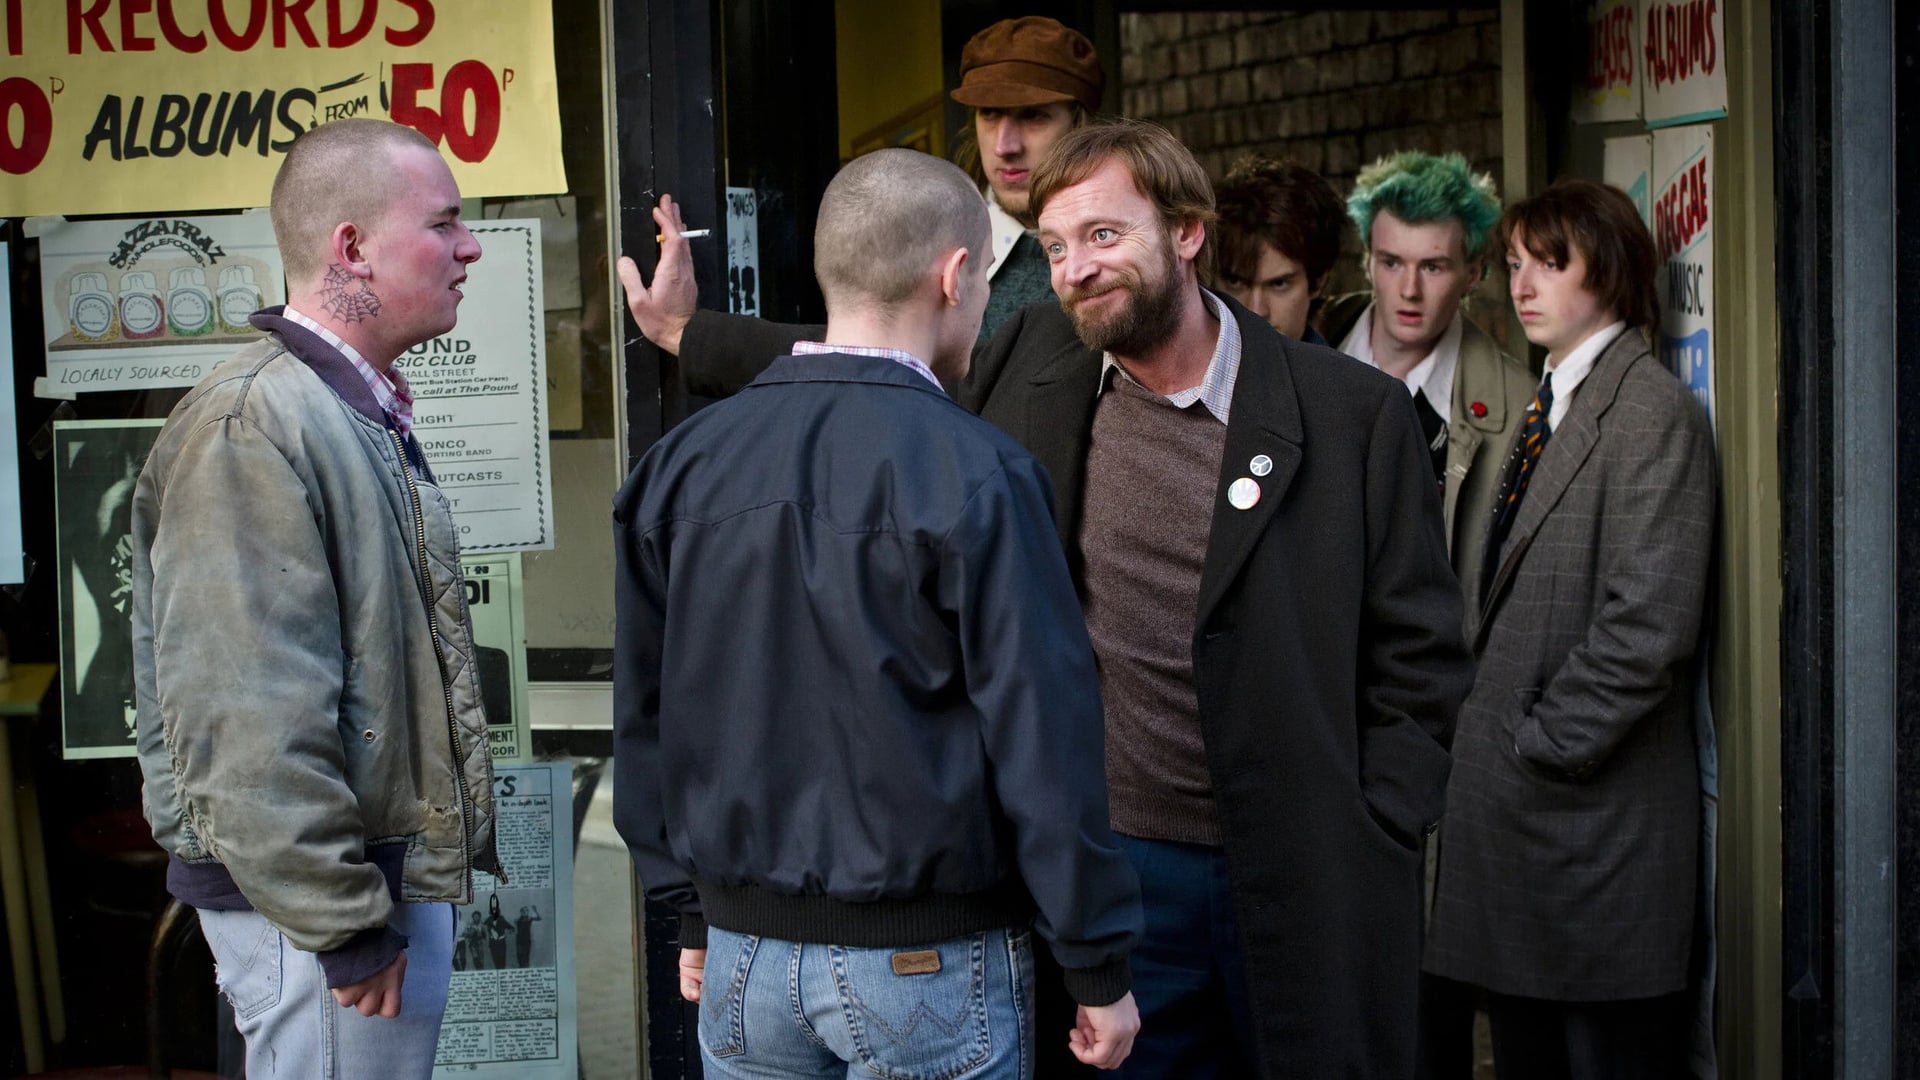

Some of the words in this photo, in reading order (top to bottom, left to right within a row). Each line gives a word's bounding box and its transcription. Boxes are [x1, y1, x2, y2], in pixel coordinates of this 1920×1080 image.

[67, 0, 435, 54] RECORDS
[1645, 0, 1717, 92] ALBUMS
[83, 88, 317, 161] ALBUMS
[325, 95, 368, 122] FROM
[1655, 156, 1708, 267] REGGAE
[109, 220, 226, 269] SAZZAFRAZ
[1668, 262, 1705, 317] MUSIC
[428, 354, 477, 367] CLUB
[60, 366, 123, 384] LOCALLY
[129, 365, 202, 380] SOURCED
[402, 370, 430, 379] HALL
[432, 368, 476, 378] STREET
[445, 377, 472, 385] Station
[422, 388, 443, 396] call
[459, 385, 480, 393] The
[481, 383, 519, 392] Pound
[413, 415, 455, 425] LIGHT
[423, 450, 462, 458] ORTING
[432, 472, 503, 482] UTCASTS
